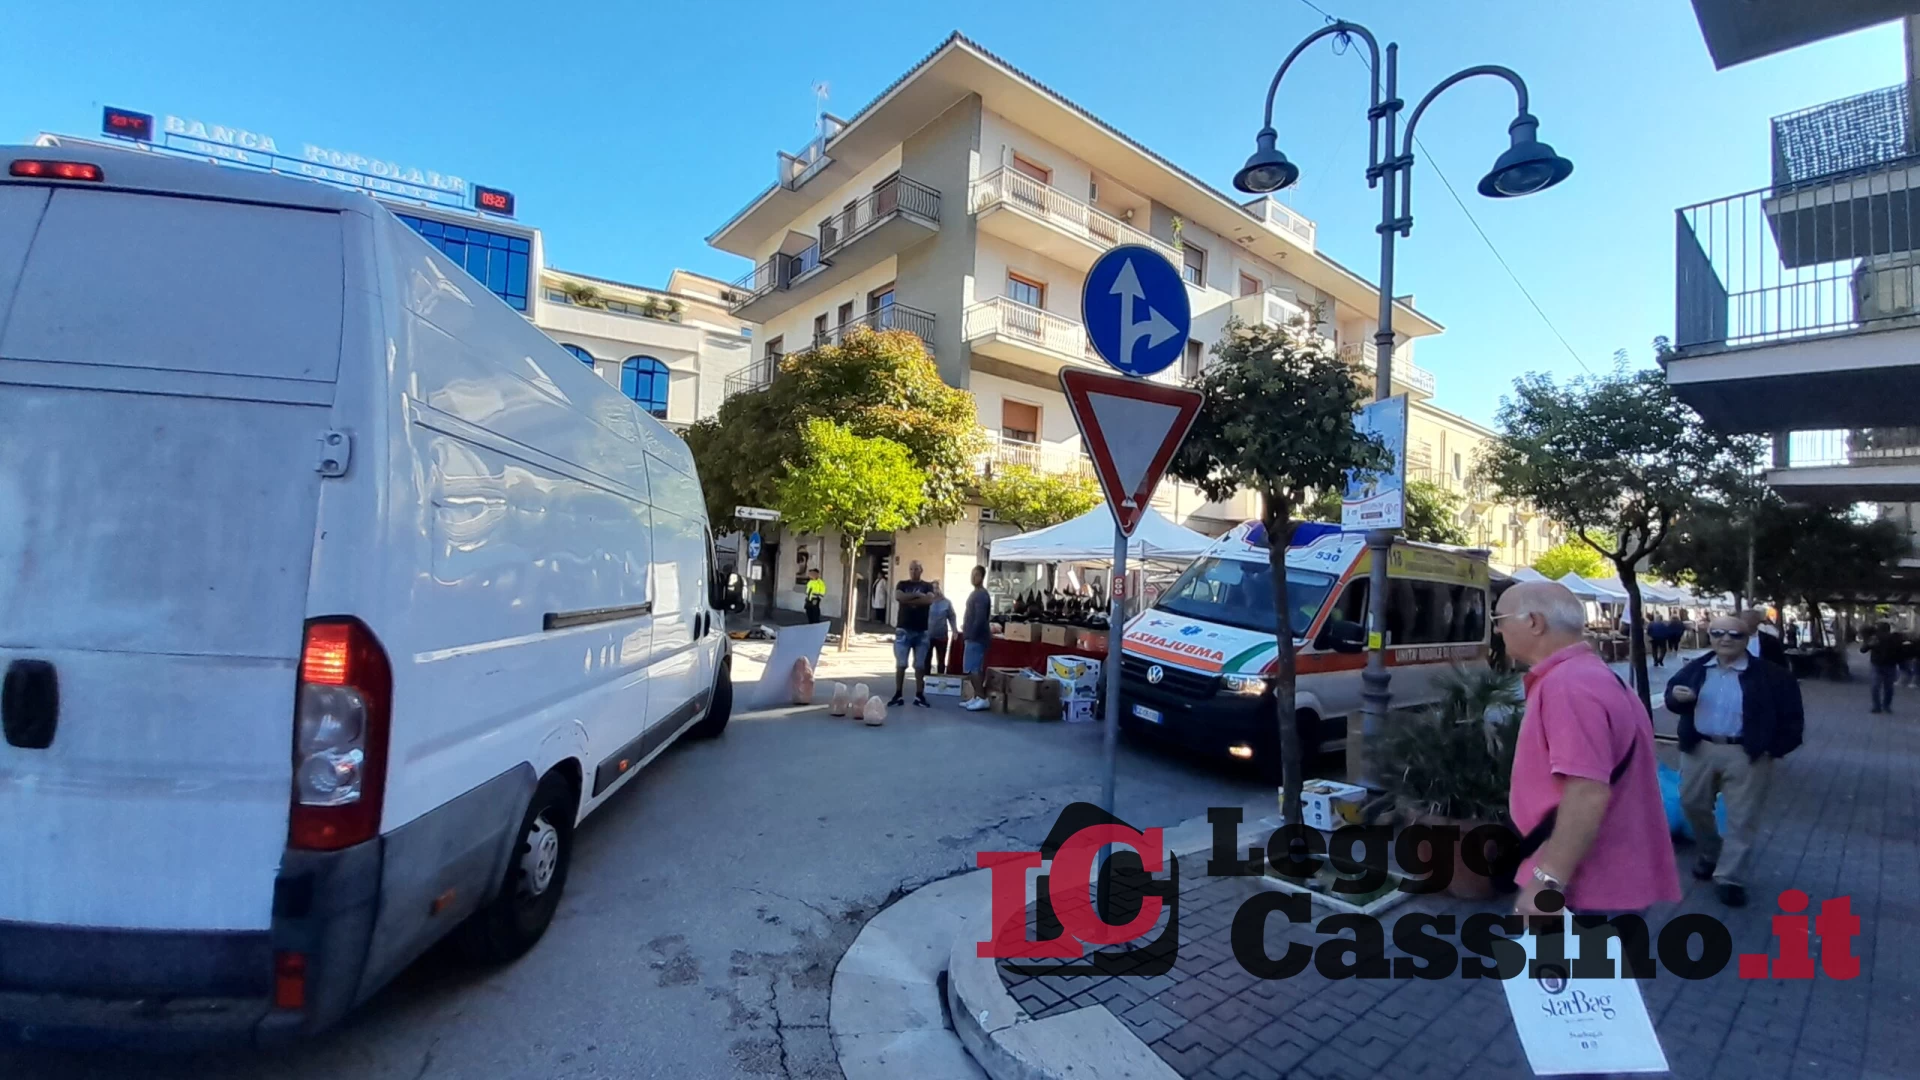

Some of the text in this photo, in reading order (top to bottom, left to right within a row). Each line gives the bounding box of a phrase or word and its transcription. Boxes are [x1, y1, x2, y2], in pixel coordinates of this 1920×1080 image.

[164, 115, 467, 190] BANCA POPOLARE
[300, 164, 440, 201] CASSINATE
[1315, 551, 1340, 562] 530
[1541, 990, 1616, 1020] starBag
